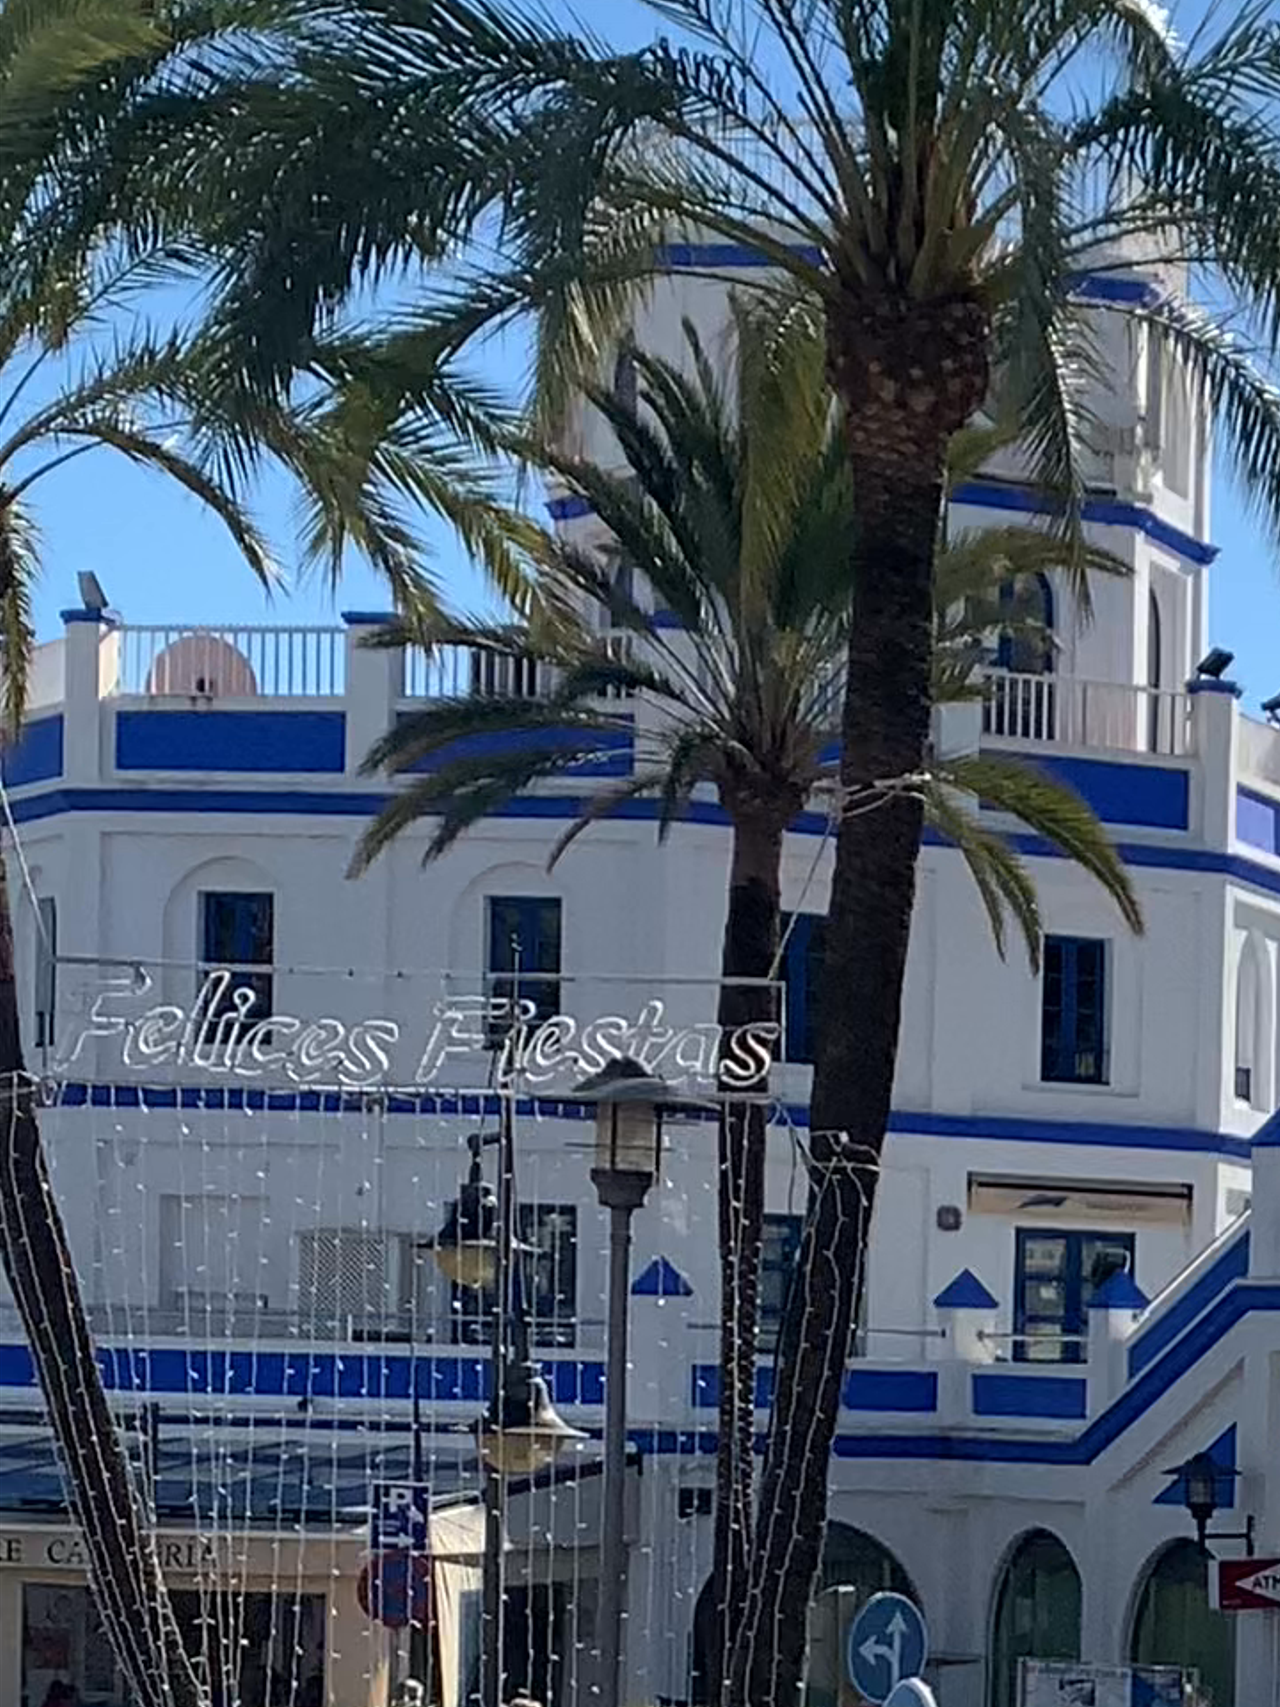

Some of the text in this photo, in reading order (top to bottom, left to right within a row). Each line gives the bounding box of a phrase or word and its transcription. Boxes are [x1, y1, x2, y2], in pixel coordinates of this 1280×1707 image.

[54, 967, 782, 1086] Felices Fiestas
[390, 1487, 414, 1513] P
